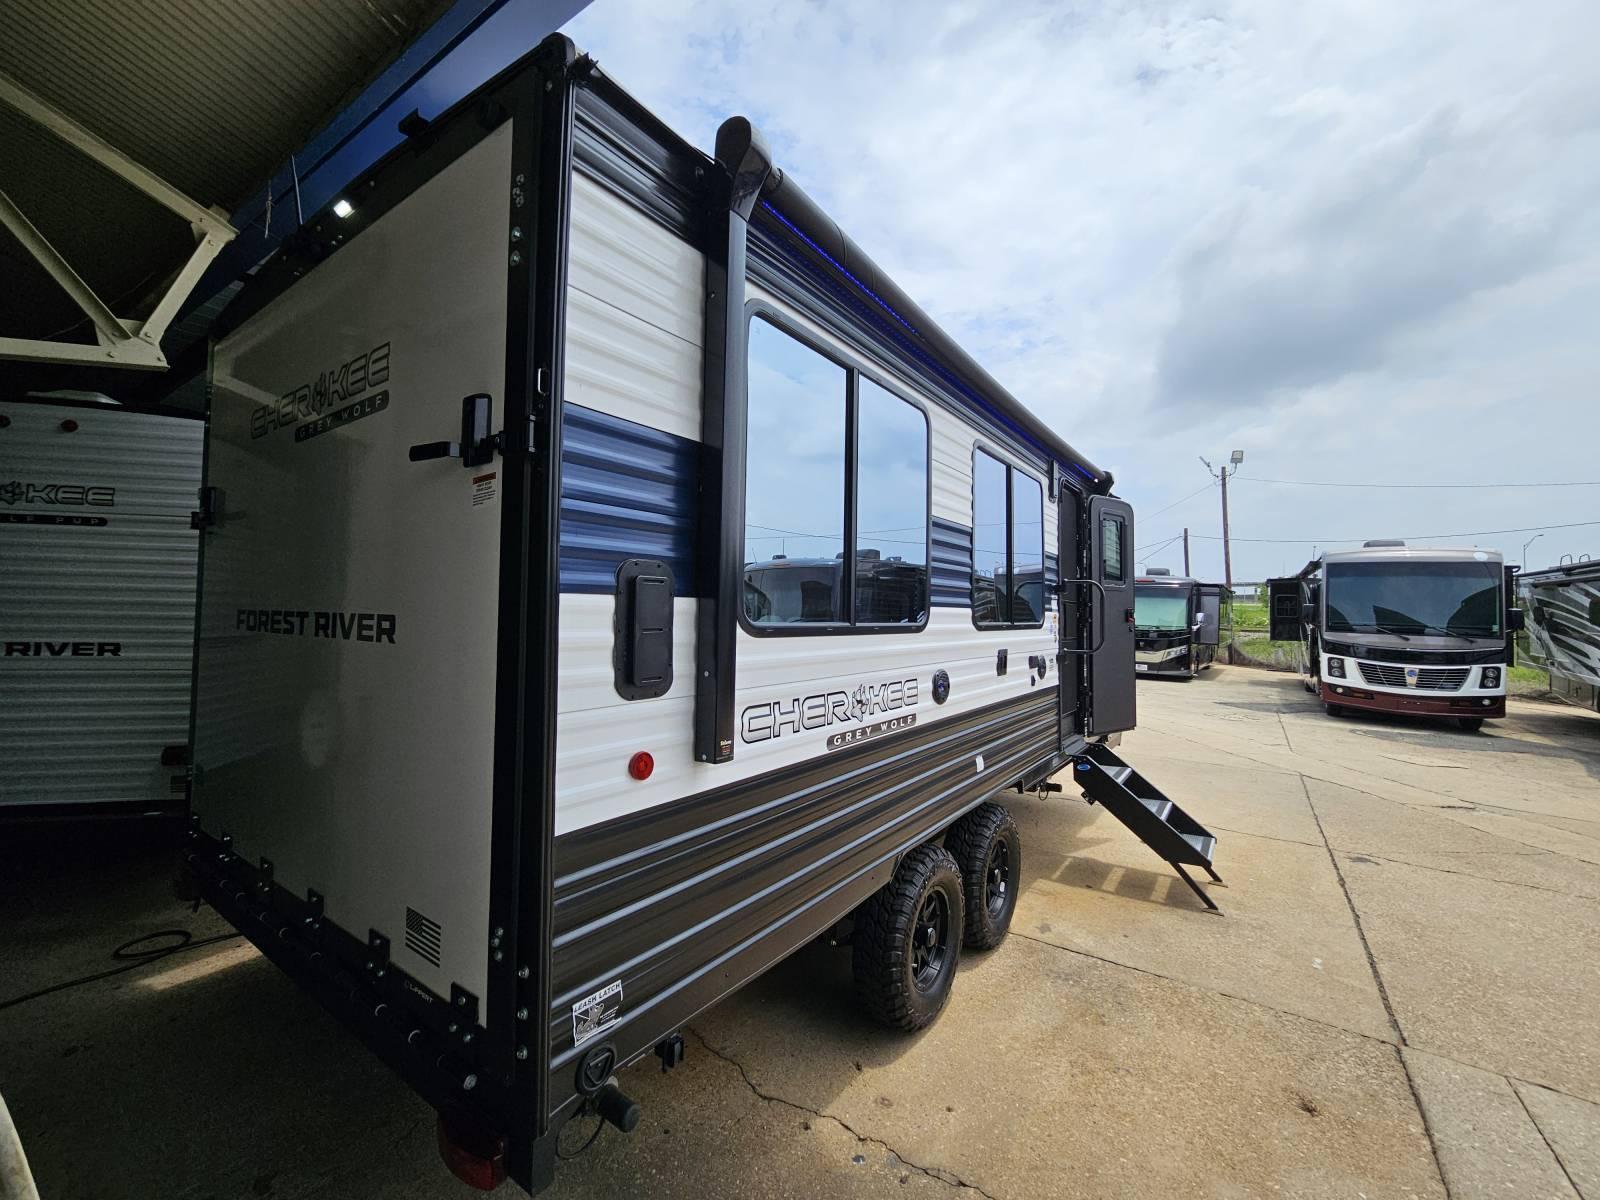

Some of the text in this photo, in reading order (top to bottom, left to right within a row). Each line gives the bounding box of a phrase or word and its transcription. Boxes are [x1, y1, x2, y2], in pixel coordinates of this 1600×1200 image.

[298, 395, 383, 440] GREY WOLF
[236, 609, 396, 645] FOREST RIVER
[4, 641, 121, 656] RIVER
[741, 679, 918, 744] CHEROKEE
[833, 715, 914, 746] GREY WOLF
[574, 982, 621, 1012] LEASH LATCH
